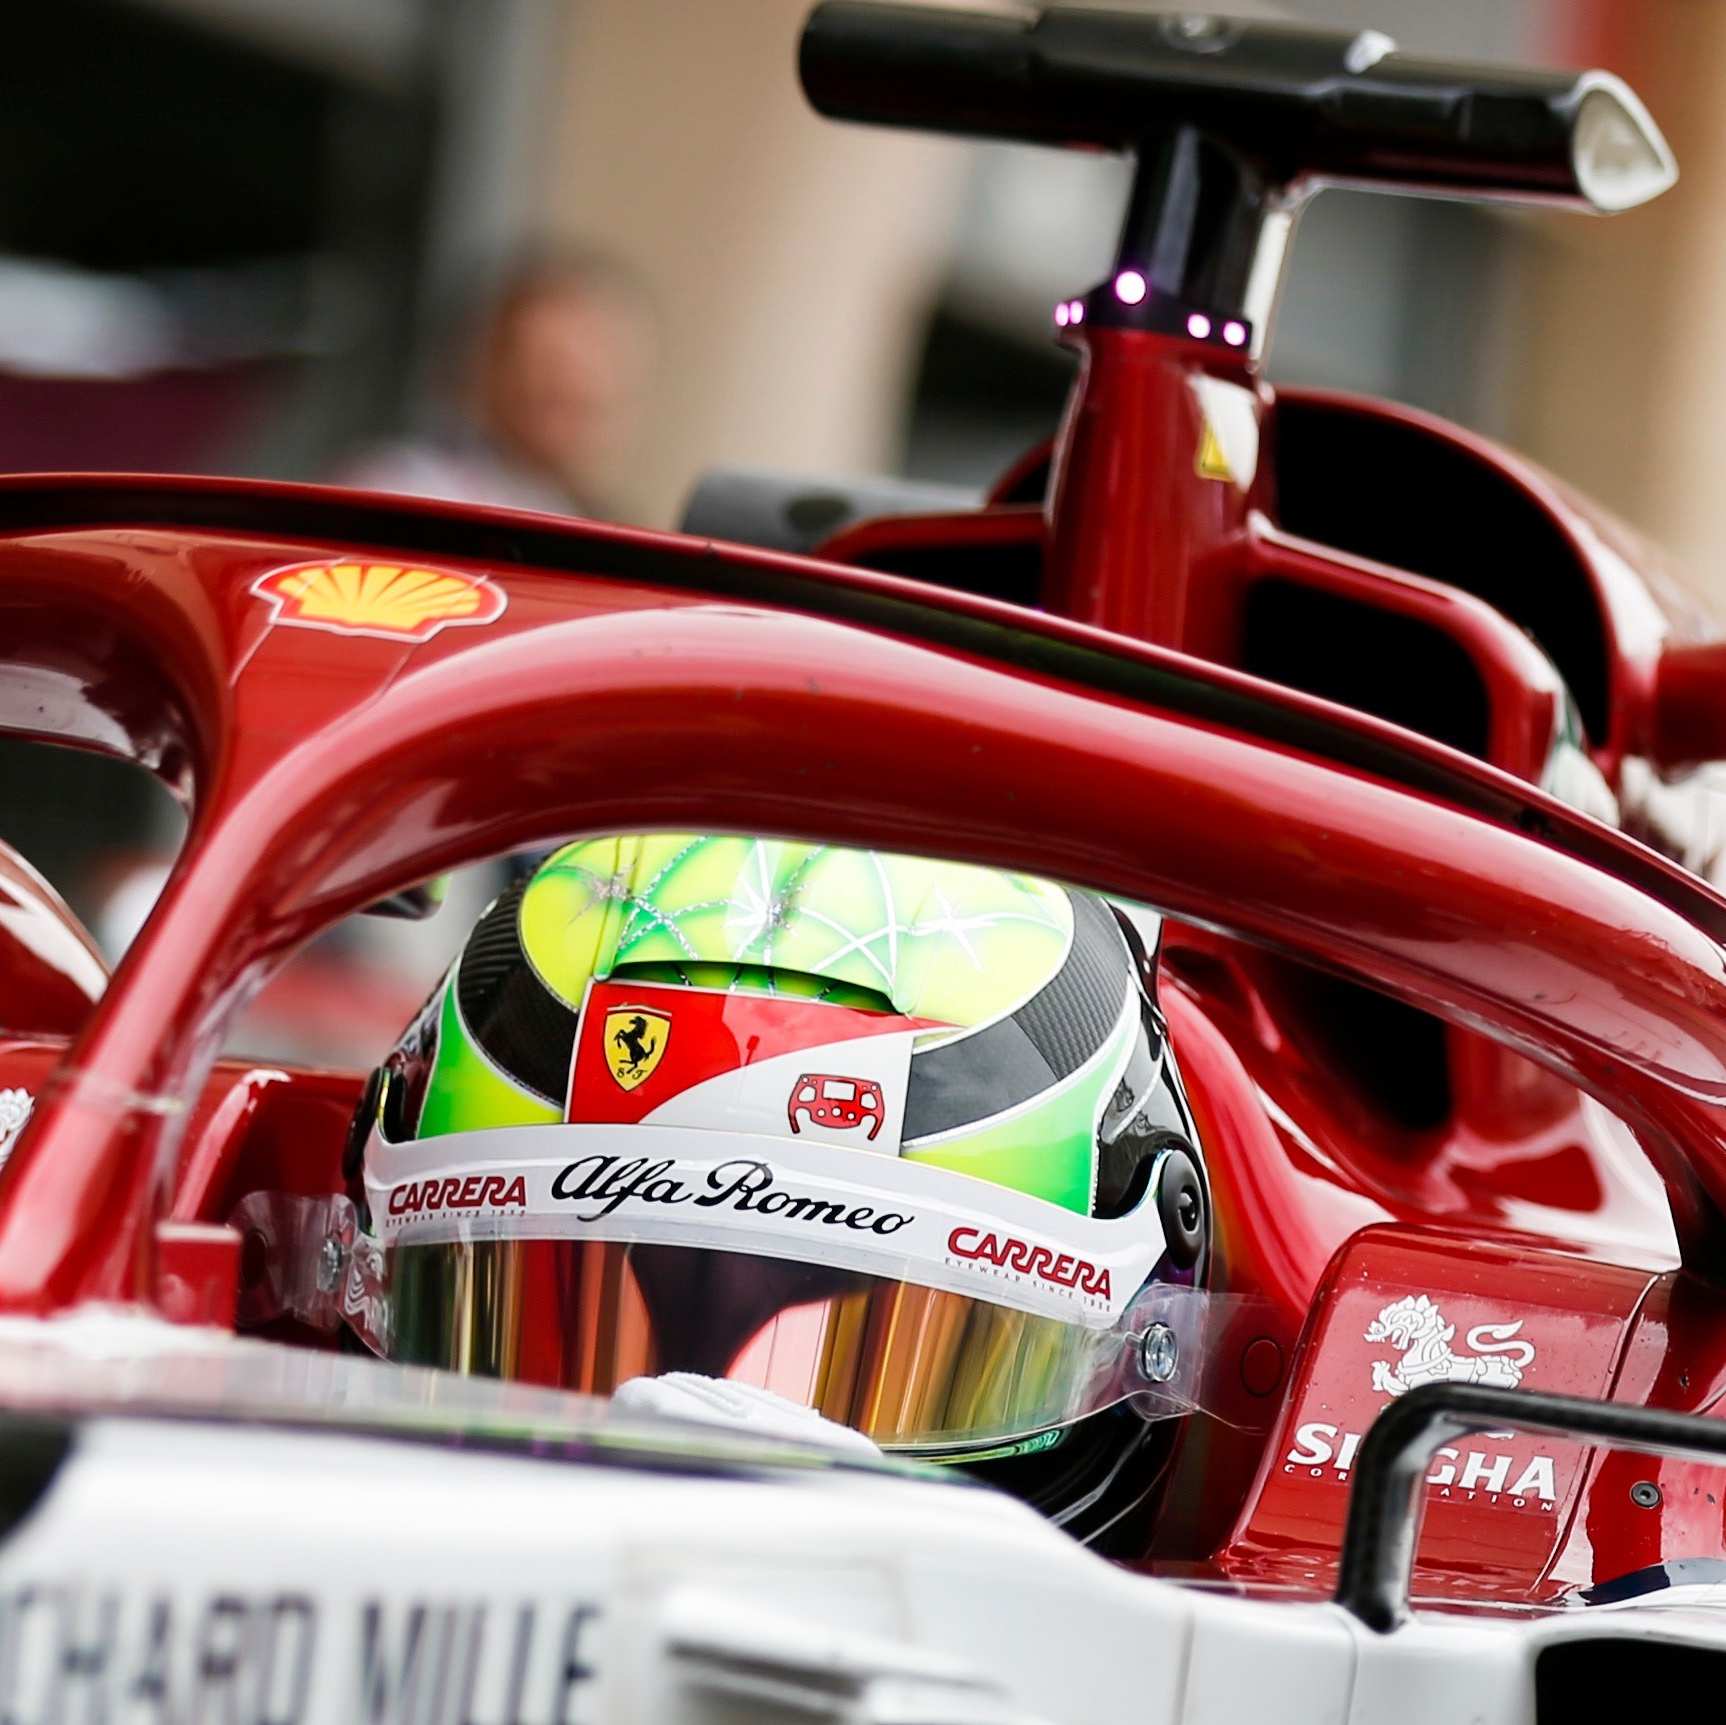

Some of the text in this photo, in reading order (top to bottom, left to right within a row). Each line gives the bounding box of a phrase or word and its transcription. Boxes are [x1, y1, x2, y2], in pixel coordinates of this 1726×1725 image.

[388, 1175, 527, 1215] CARRERA
[551, 1155, 915, 1235] Alfa Romeo
[945, 1257, 1022, 1283] EYEWEAR
[947, 1226, 1112, 1301] CARRERA
[1284, 1463, 1553, 1512] CORATION
[1286, 1422, 1556, 1501] SIGHA
